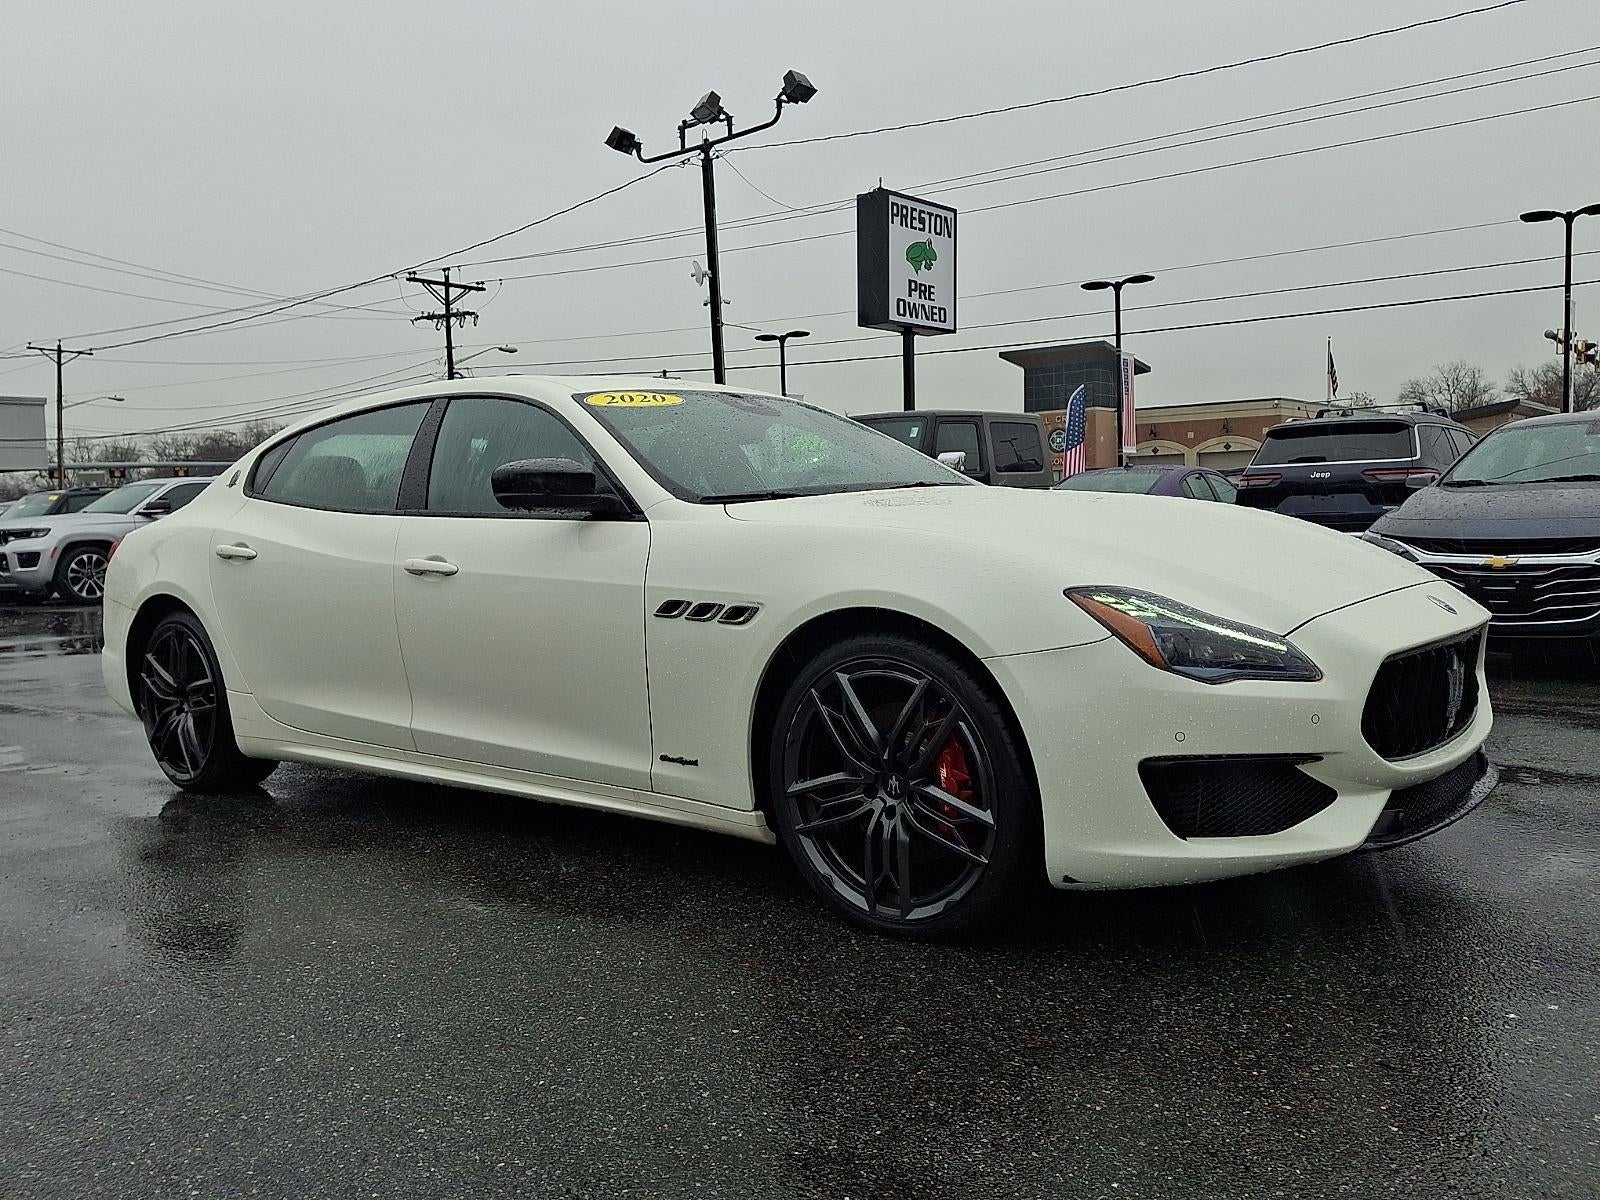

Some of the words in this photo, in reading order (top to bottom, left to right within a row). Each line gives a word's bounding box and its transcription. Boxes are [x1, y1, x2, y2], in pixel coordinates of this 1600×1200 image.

[891, 202, 952, 238] PRESTON
[907, 278, 936, 302] PRE
[896, 297, 948, 324] OWNED
[603, 394, 667, 405] 2020
[1310, 471, 1331, 479] Jeep
